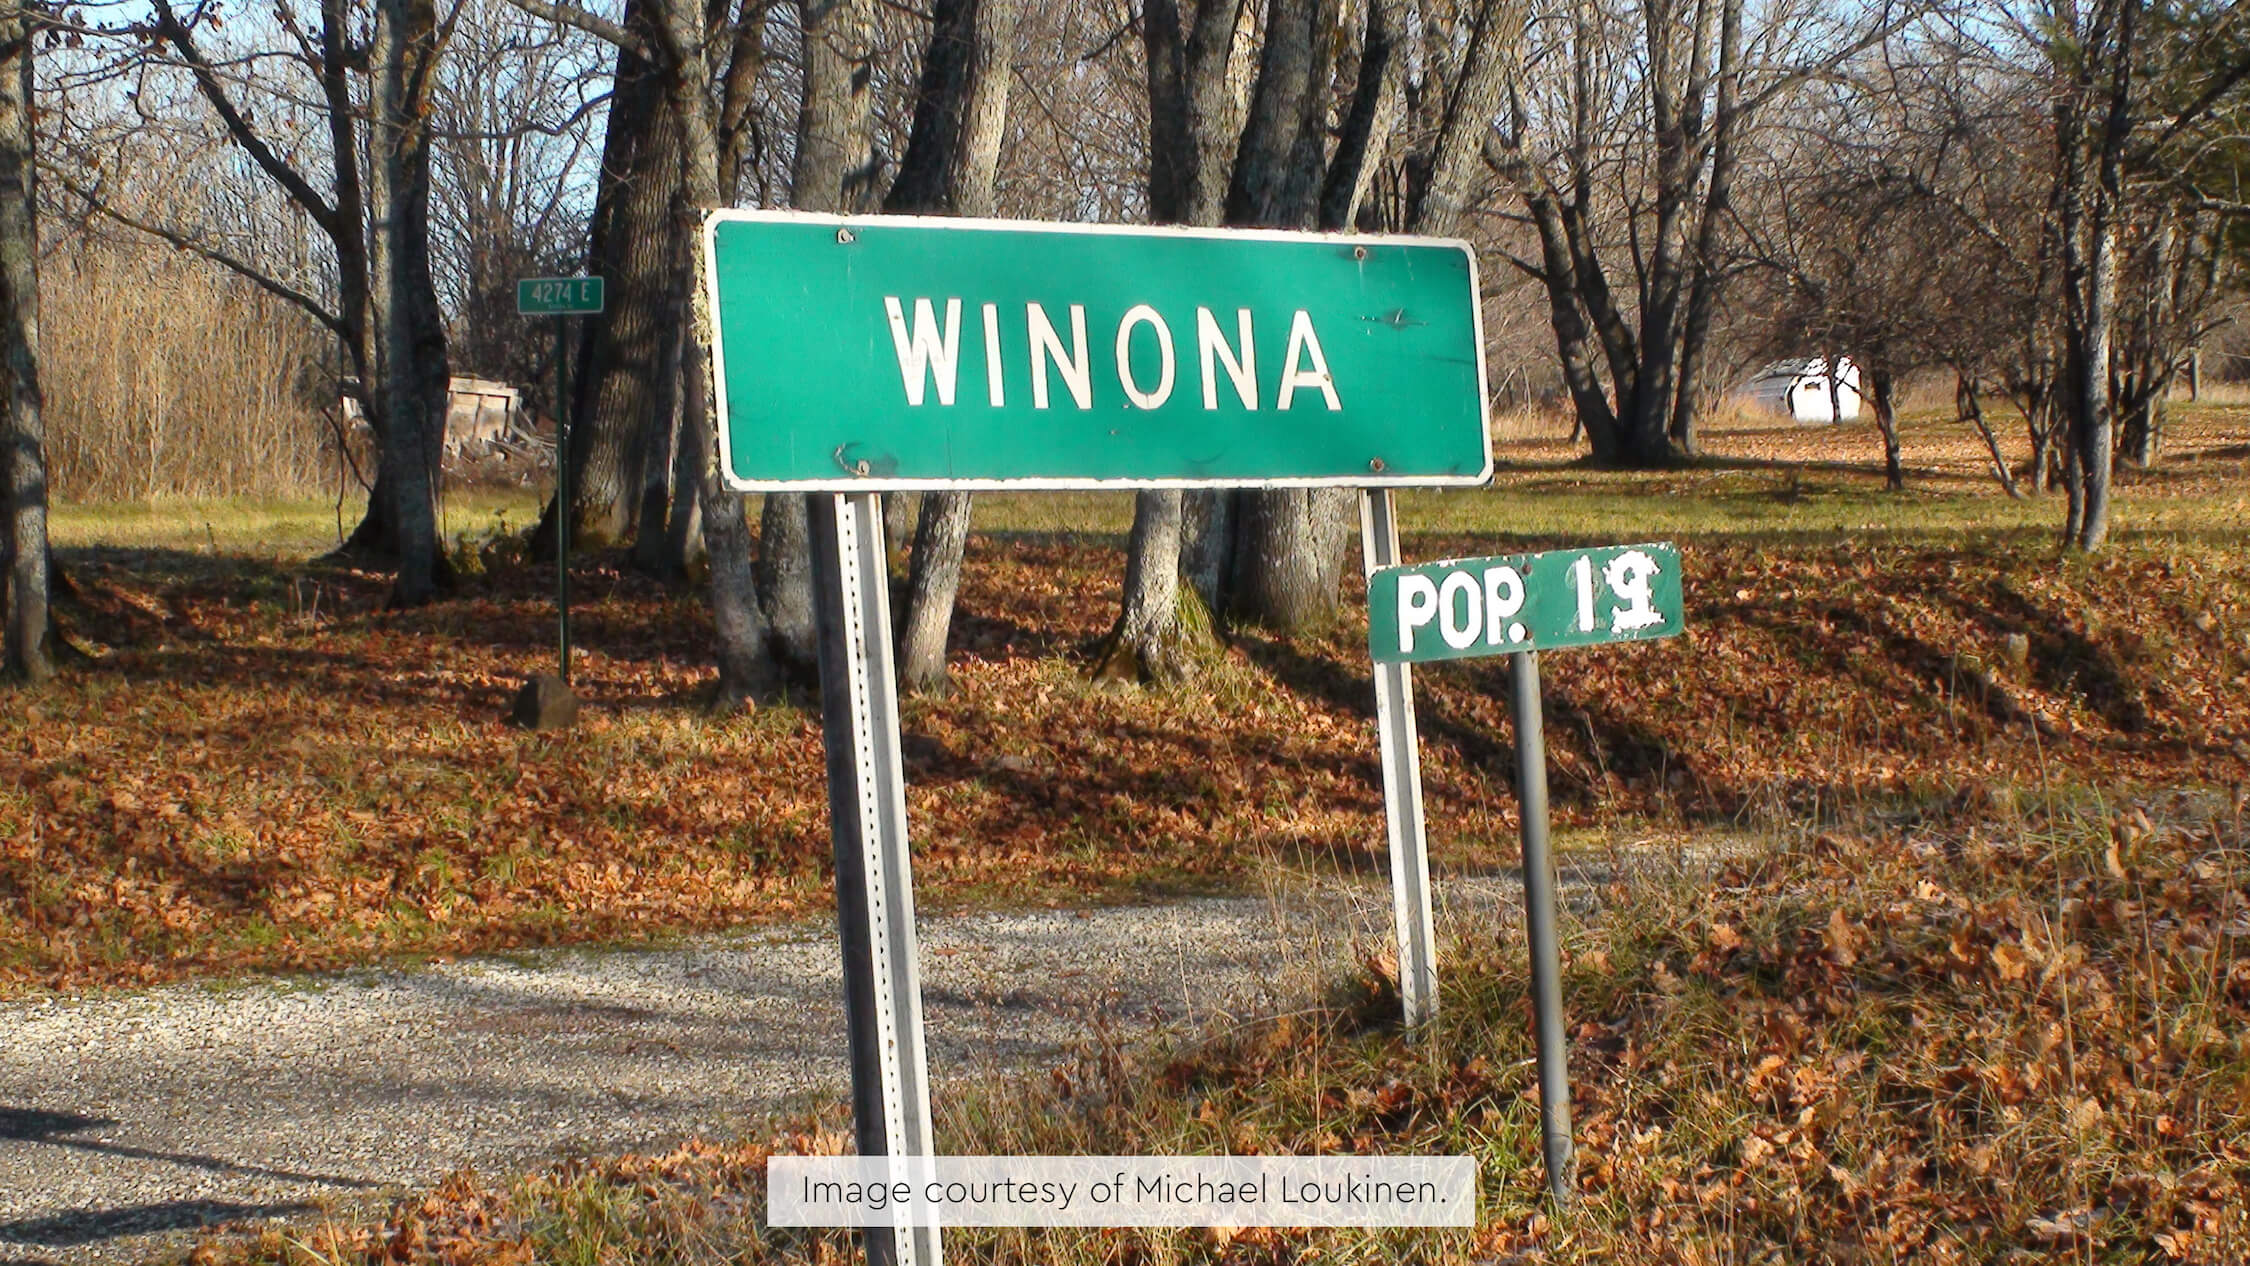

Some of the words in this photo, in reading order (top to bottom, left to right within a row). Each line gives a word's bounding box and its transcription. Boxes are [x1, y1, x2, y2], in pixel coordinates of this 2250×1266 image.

[531, 282, 572, 303] 4274
[581, 281, 590, 302] E
[884, 296, 1342, 411] WINONA
[1398, 566, 1526, 653] POP.
